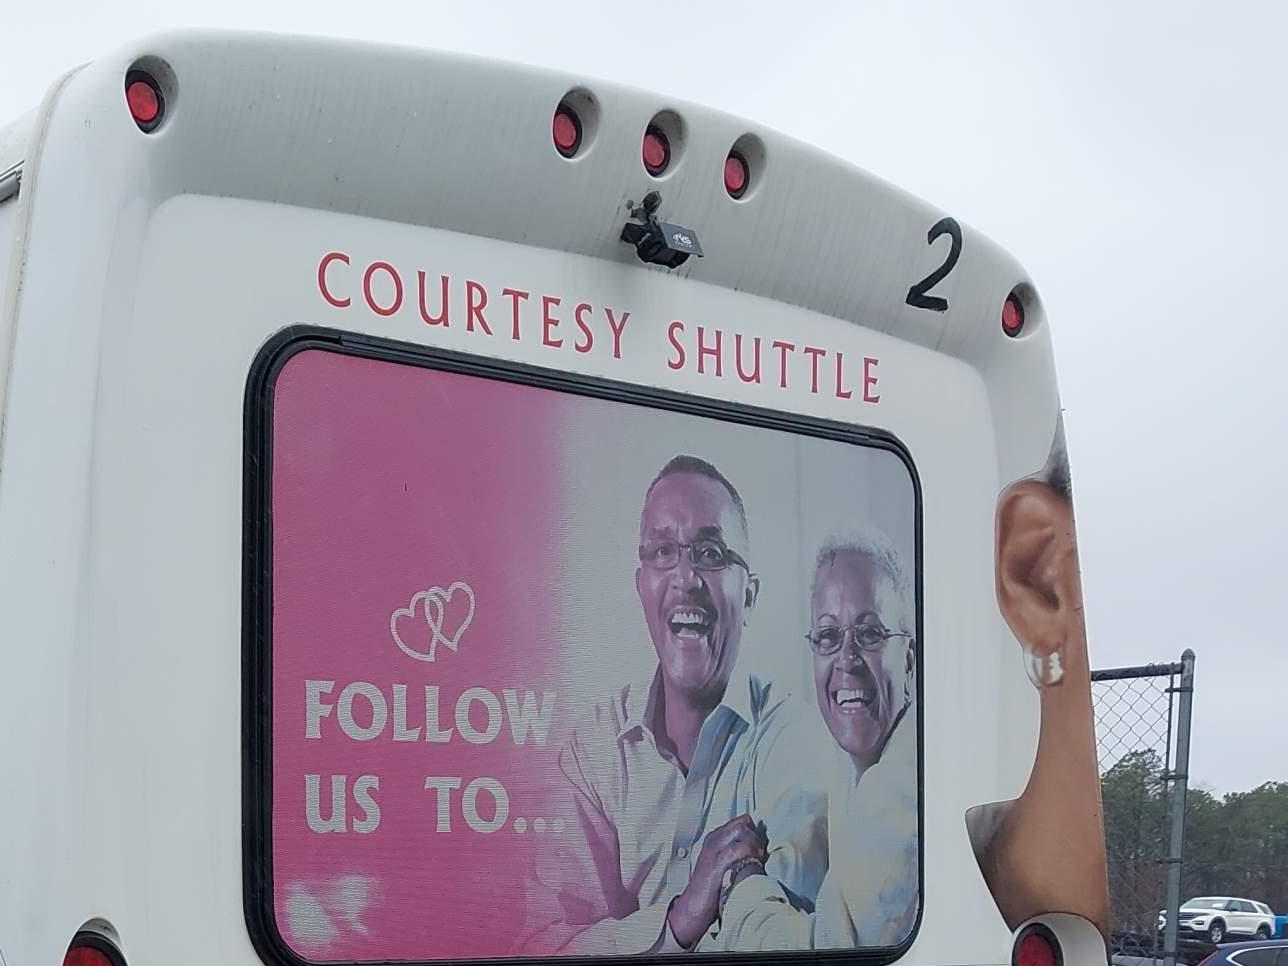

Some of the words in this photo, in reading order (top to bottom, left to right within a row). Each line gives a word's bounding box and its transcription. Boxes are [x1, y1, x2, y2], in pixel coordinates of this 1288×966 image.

[905, 216, 963, 313] 2
[317, 251, 631, 360] COURTESY
[667, 320, 881, 404] SHUTTLE
[303, 679, 558, 746] FOLLOW
[303, 774, 382, 834] US
[424, 776, 566, 834] TO...
